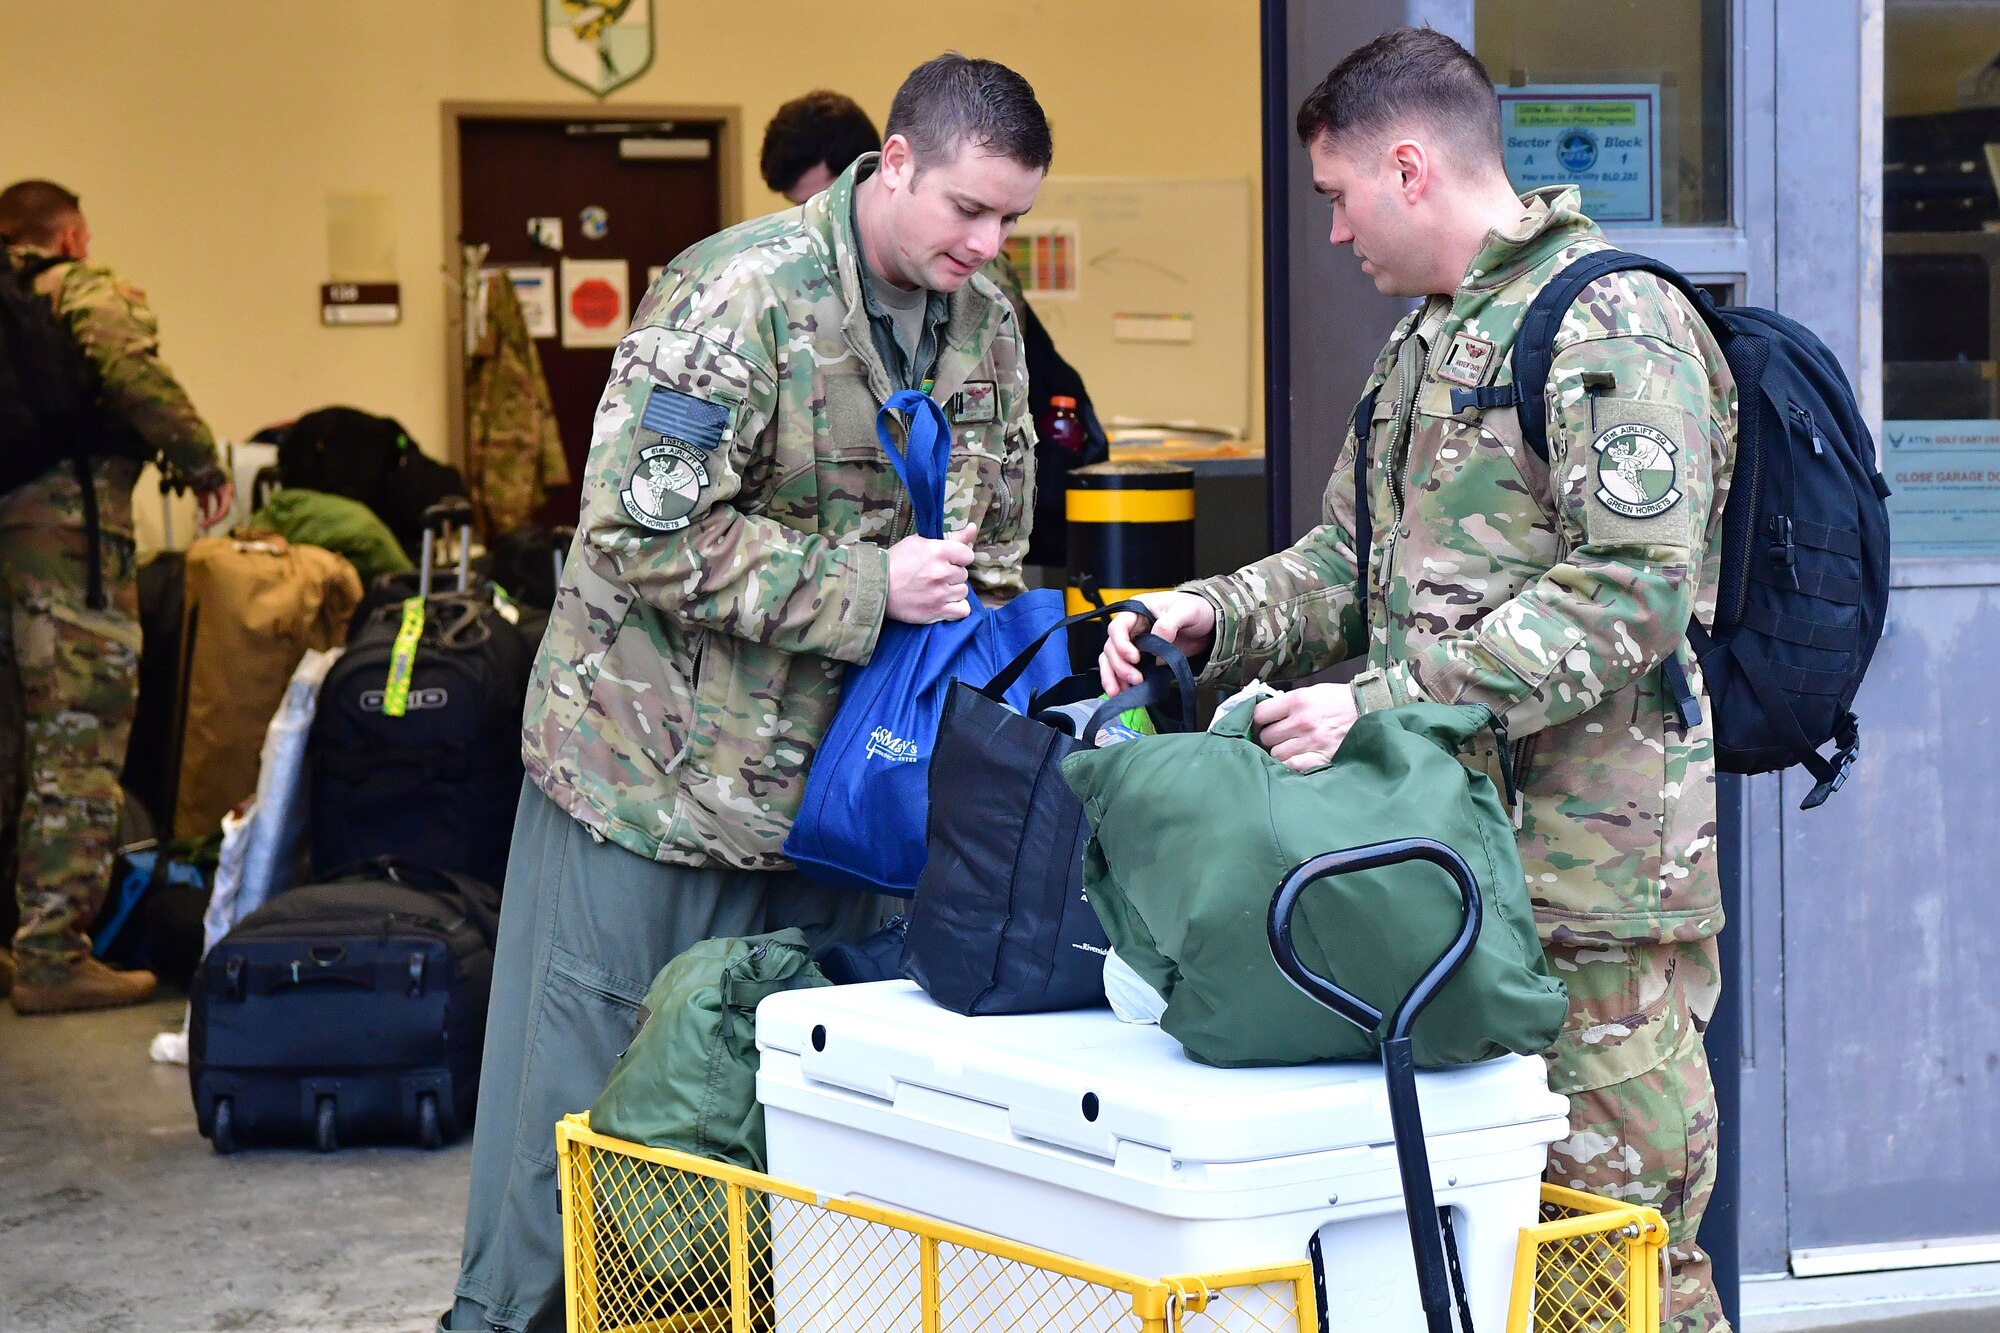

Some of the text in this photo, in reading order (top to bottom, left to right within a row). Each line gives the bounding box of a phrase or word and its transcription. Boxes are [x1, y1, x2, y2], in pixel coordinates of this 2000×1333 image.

[1507, 136, 1552, 148] Sector
[1604, 136, 1642, 148] Block
[1524, 154, 1534, 166] A
[1620, 426, 1654, 436] AIRLIFT
[1655, 433, 1667, 445] SQ
[664, 437, 706, 461] INSTRUCTOR
[669, 447, 697, 466] AIRLIFT
[694, 464, 706, 477] SQ
[1895, 472, 1933, 483] CLOSE
[1936, 472, 1984, 483] GARAGE
[1606, 497, 1672, 514] GREEN HORNETS
[625, 500, 680, 529] GREEN HORNETS
